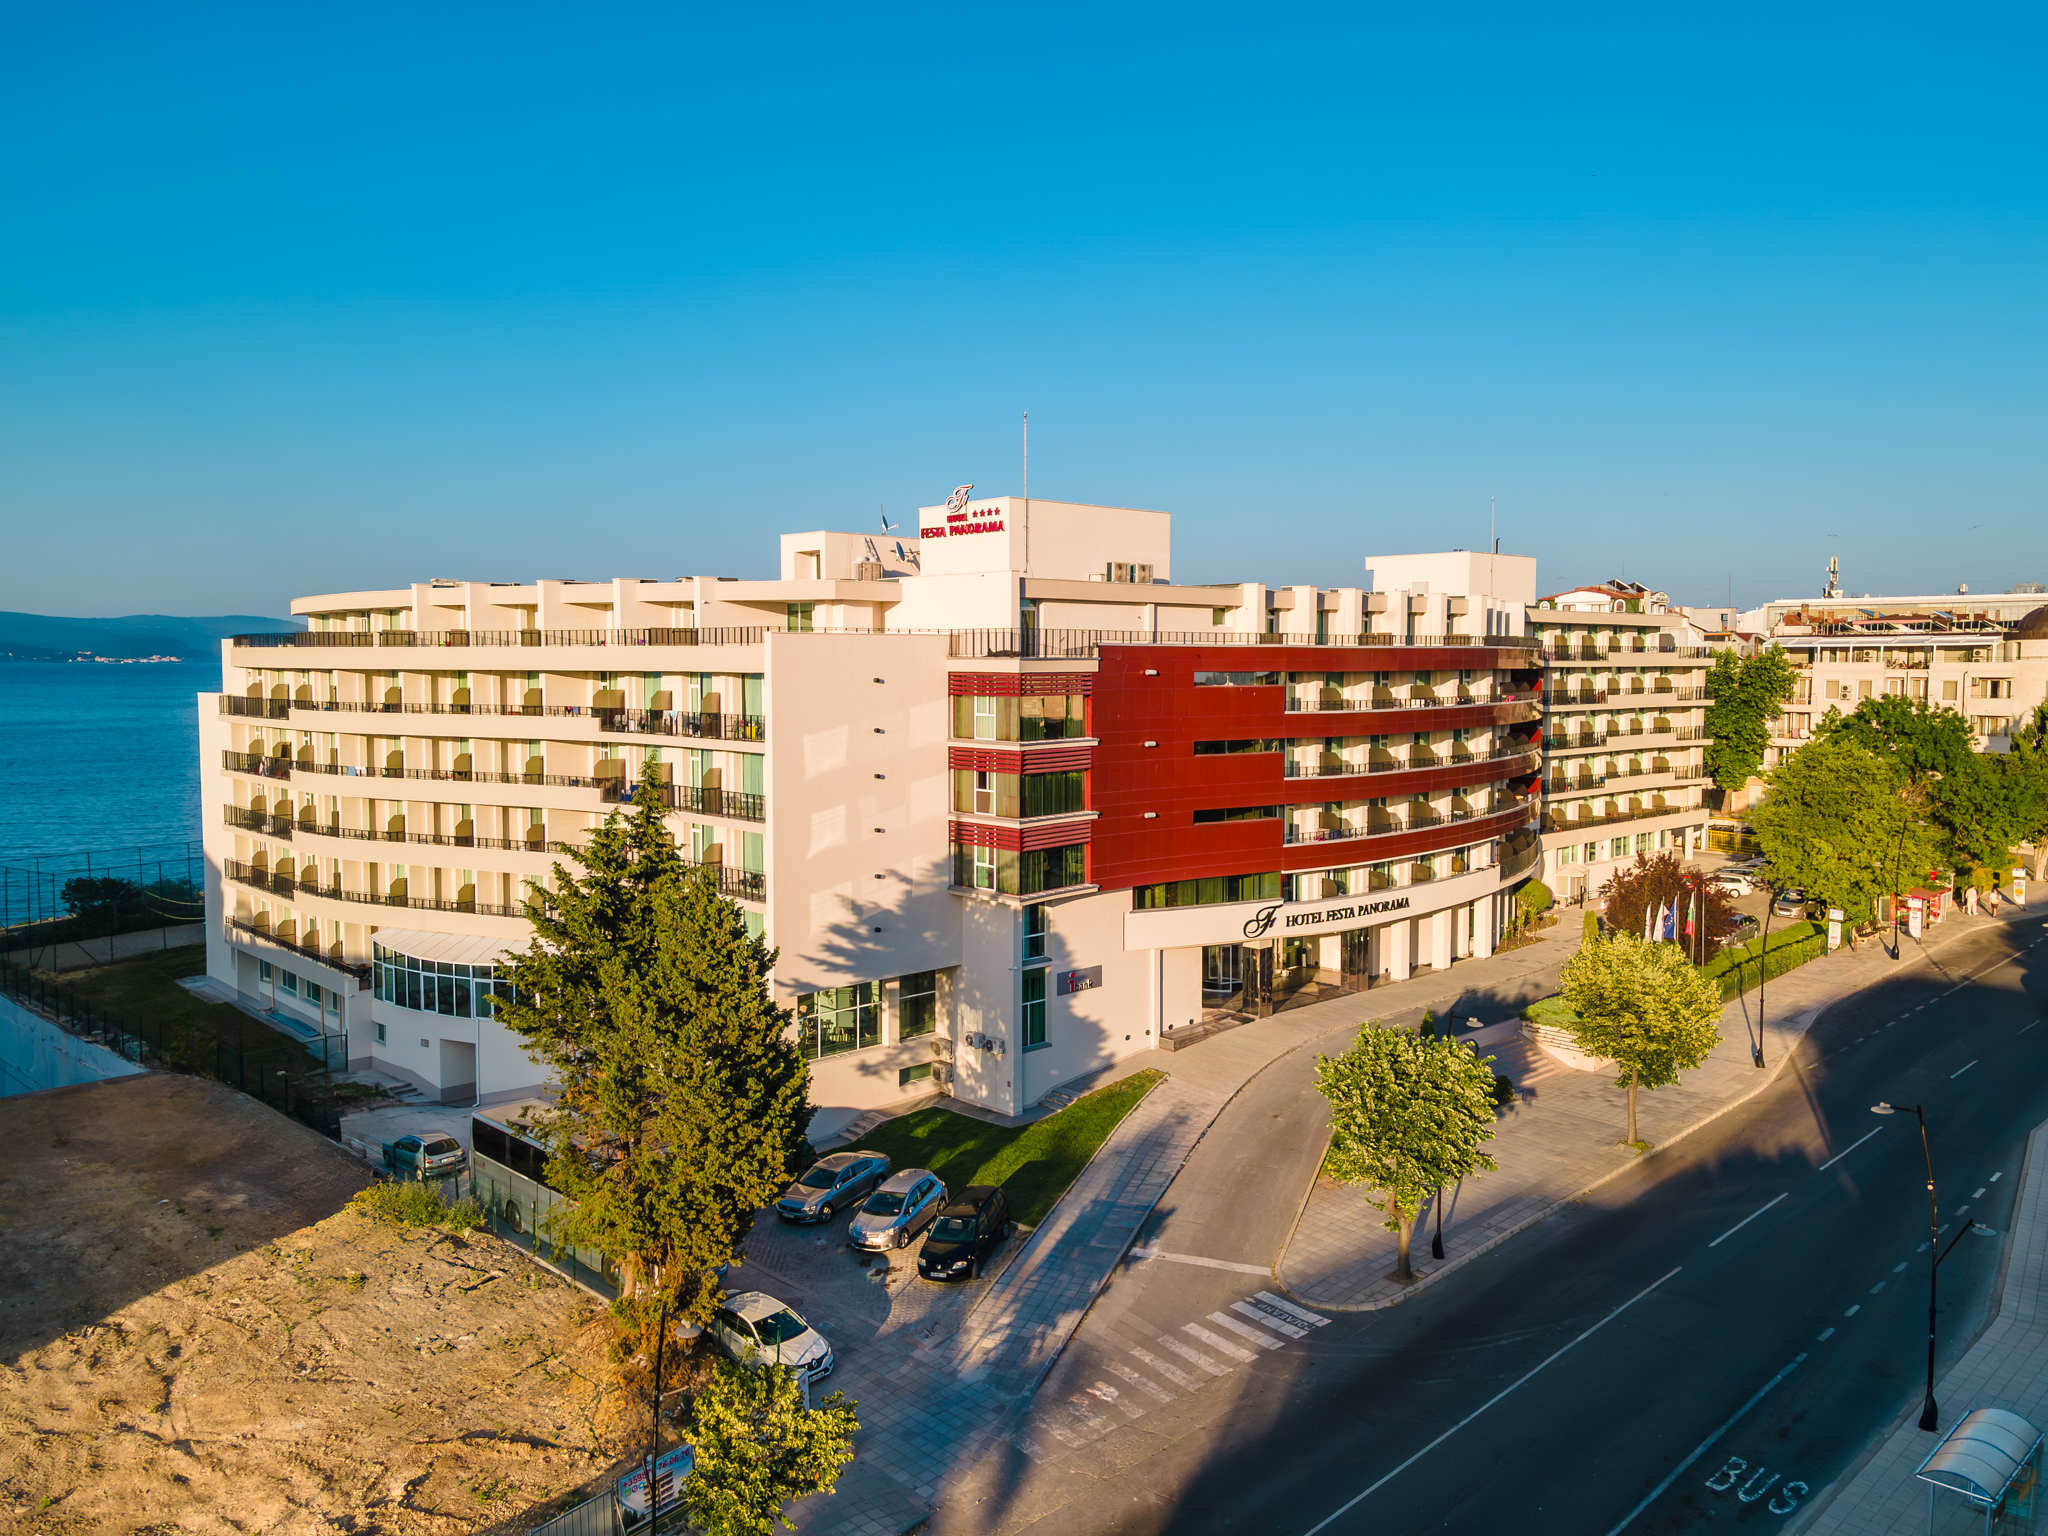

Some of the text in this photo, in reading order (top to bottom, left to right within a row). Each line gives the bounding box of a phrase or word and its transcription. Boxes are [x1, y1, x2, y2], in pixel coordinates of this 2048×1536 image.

[921, 520, 1005, 539] FESTA PANORAMA
[1285, 897, 1411, 927] HOTEL FESTA PANORAMA
[1705, 1456, 1809, 1514] BUS
